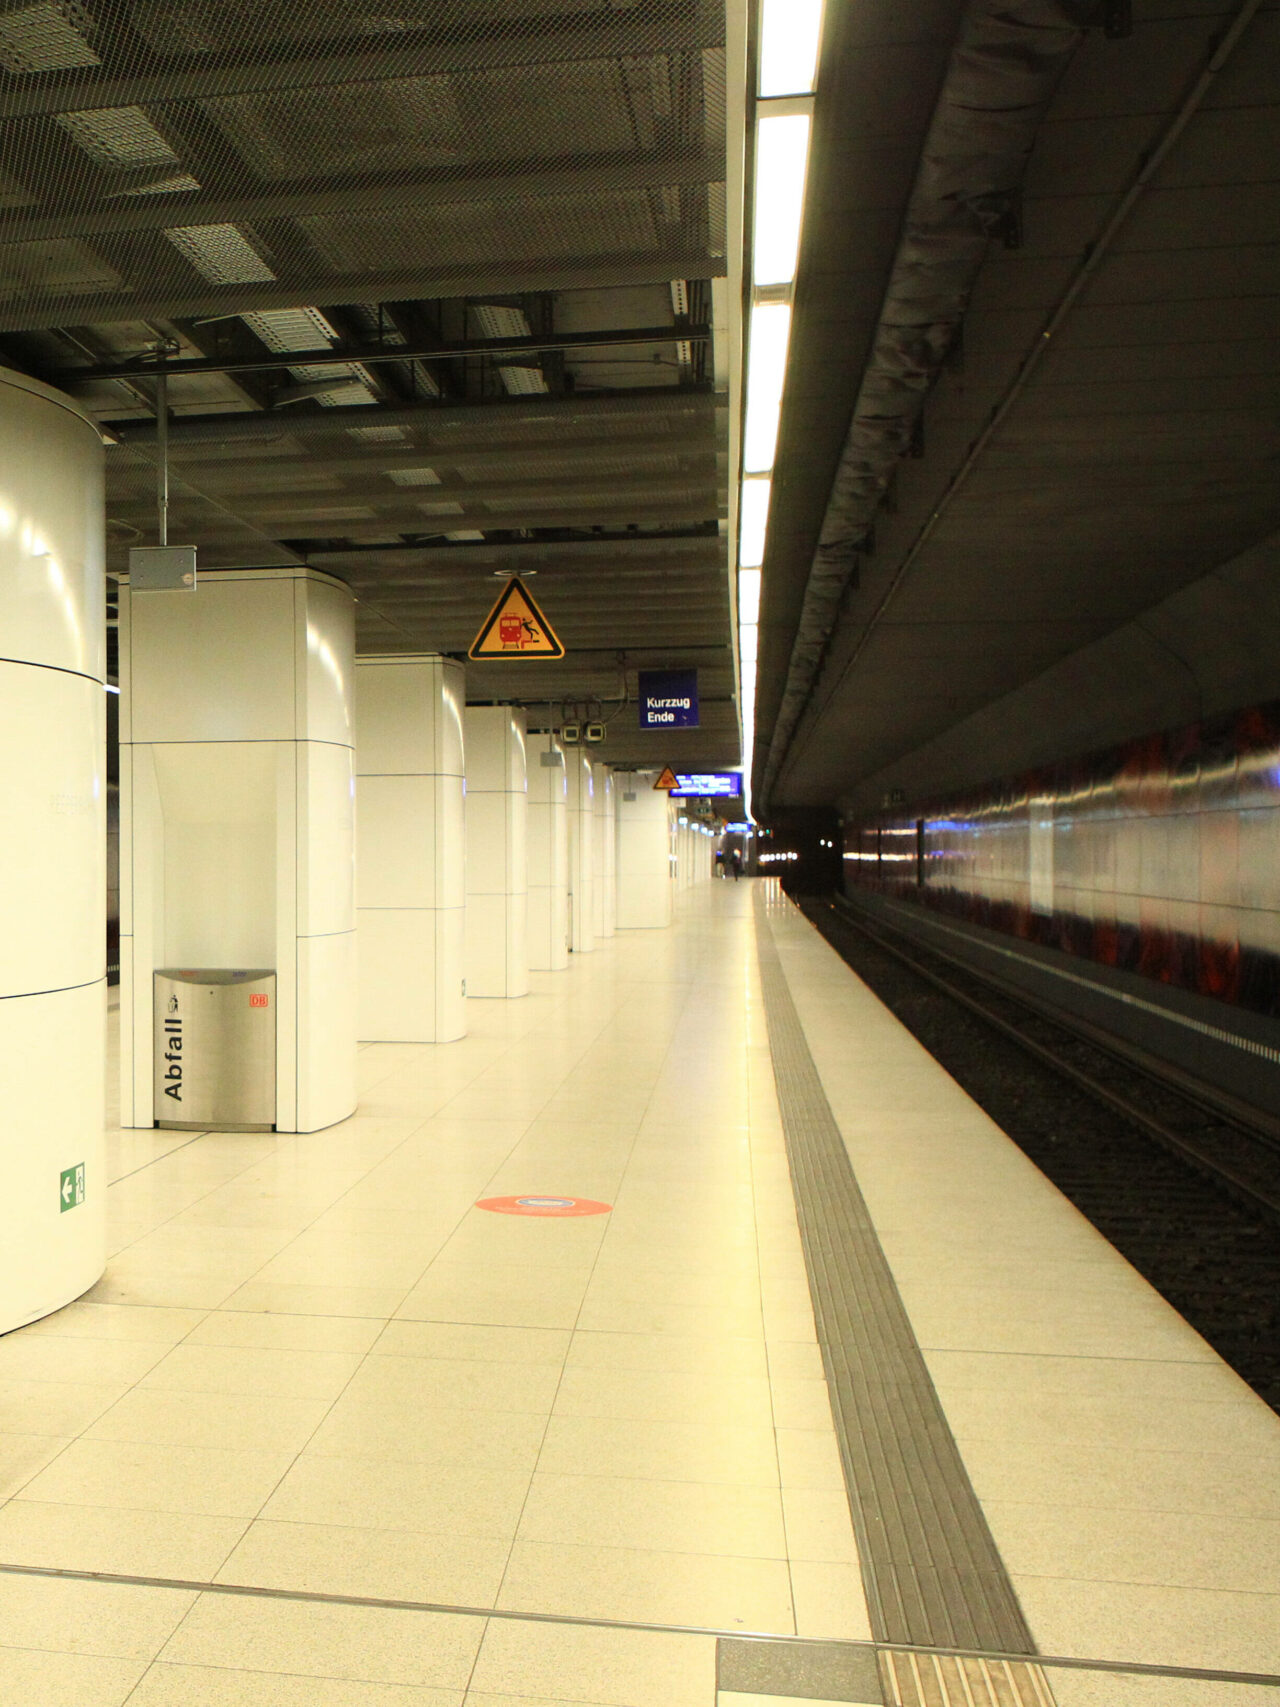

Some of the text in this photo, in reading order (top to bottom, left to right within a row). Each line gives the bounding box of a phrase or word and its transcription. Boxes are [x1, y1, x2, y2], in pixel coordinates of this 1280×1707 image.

[646, 696, 691, 709] Kurzzug
[646, 711, 675, 723] Ende
[251, 995, 267, 1006] DB
[164, 1018, 183, 1102] Abfall
